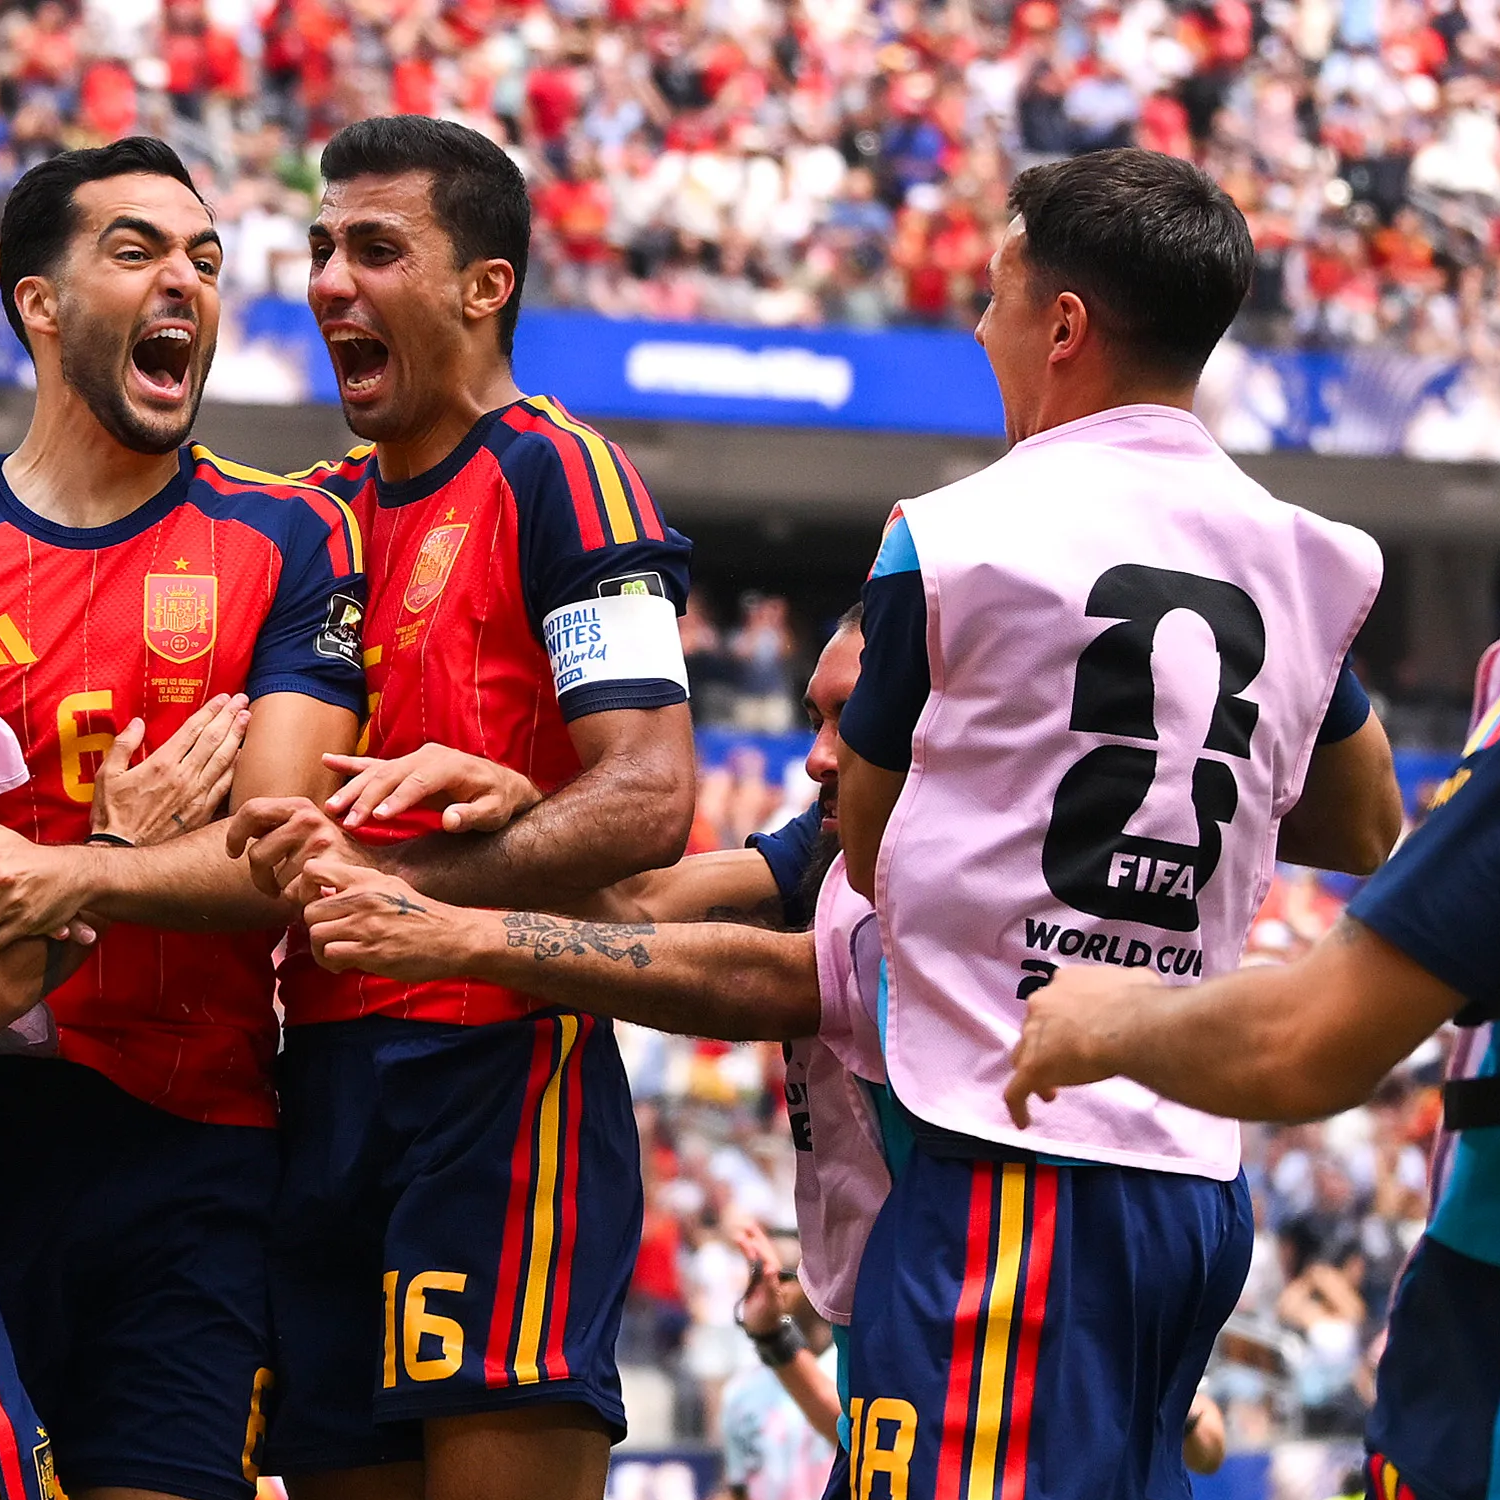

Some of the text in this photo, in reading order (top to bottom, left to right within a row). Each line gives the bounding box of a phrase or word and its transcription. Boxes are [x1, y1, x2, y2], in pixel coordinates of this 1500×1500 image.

[544, 607, 601, 638] OOTBALL
[548, 623, 602, 659] NITES
[557, 643, 607, 672] World
[56, 690, 114, 803] 6
[1107, 852, 1197, 900] FIFA
[1025, 917, 1153, 968] WORLD
[382, 1270, 468, 1389] 16
